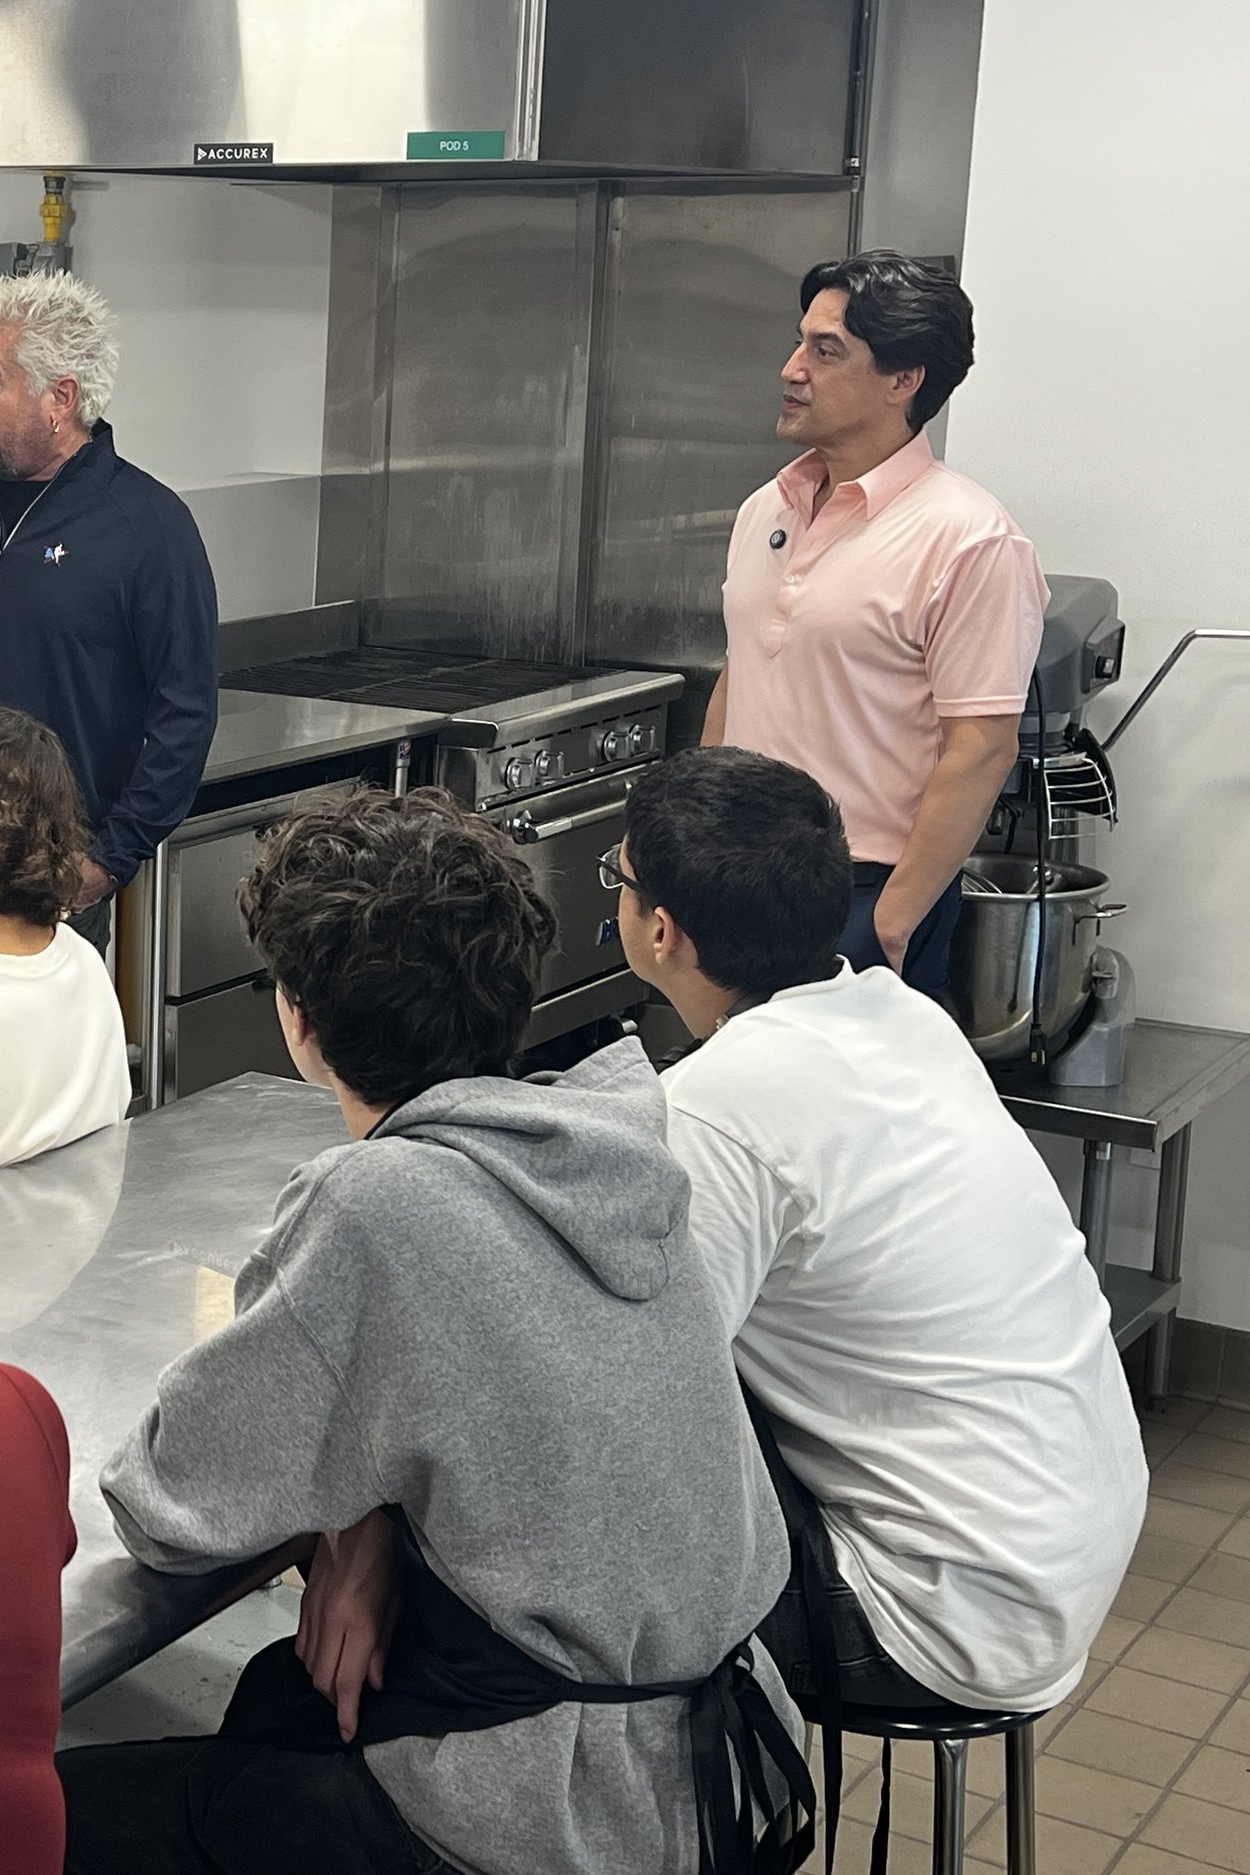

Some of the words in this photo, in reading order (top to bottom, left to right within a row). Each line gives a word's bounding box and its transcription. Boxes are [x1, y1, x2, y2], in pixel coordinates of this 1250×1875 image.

[440, 141, 461, 151] POD
[462, 141, 469, 151] 5
[208, 148, 268, 159] ACCUREX
